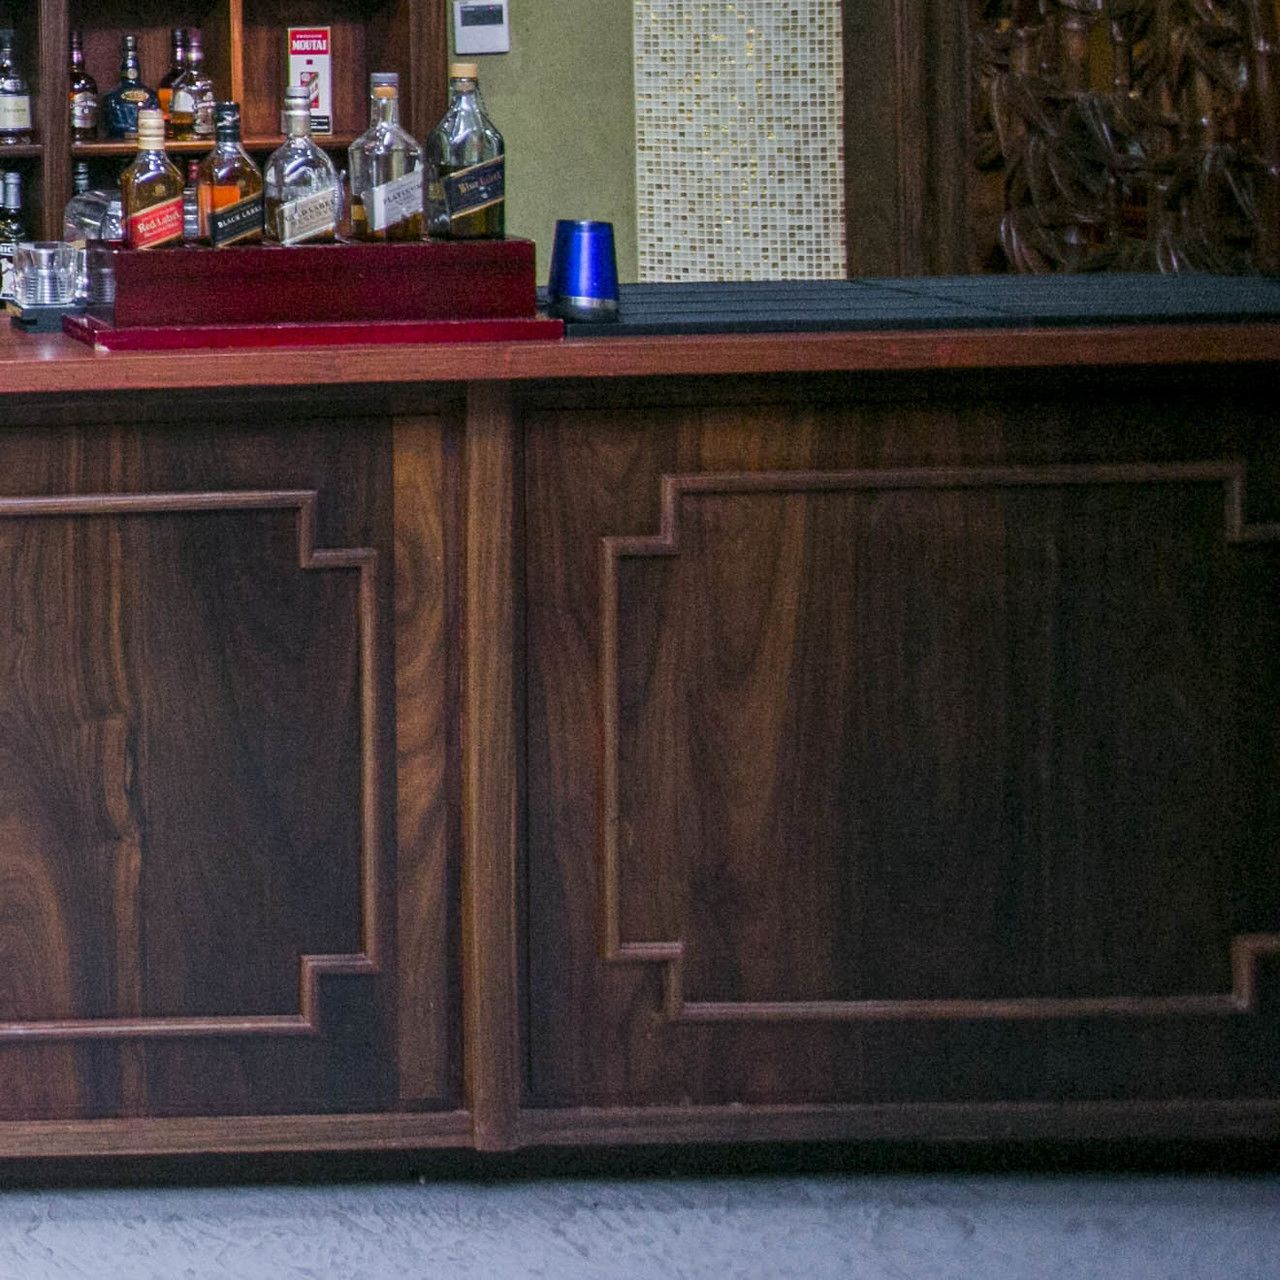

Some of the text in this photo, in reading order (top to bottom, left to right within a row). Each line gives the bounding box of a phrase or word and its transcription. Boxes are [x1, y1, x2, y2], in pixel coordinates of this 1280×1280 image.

[292, 40, 327, 51] MOUTAI
[138, 212, 180, 233] Red Label
[217, 214, 241, 229] BLACK
